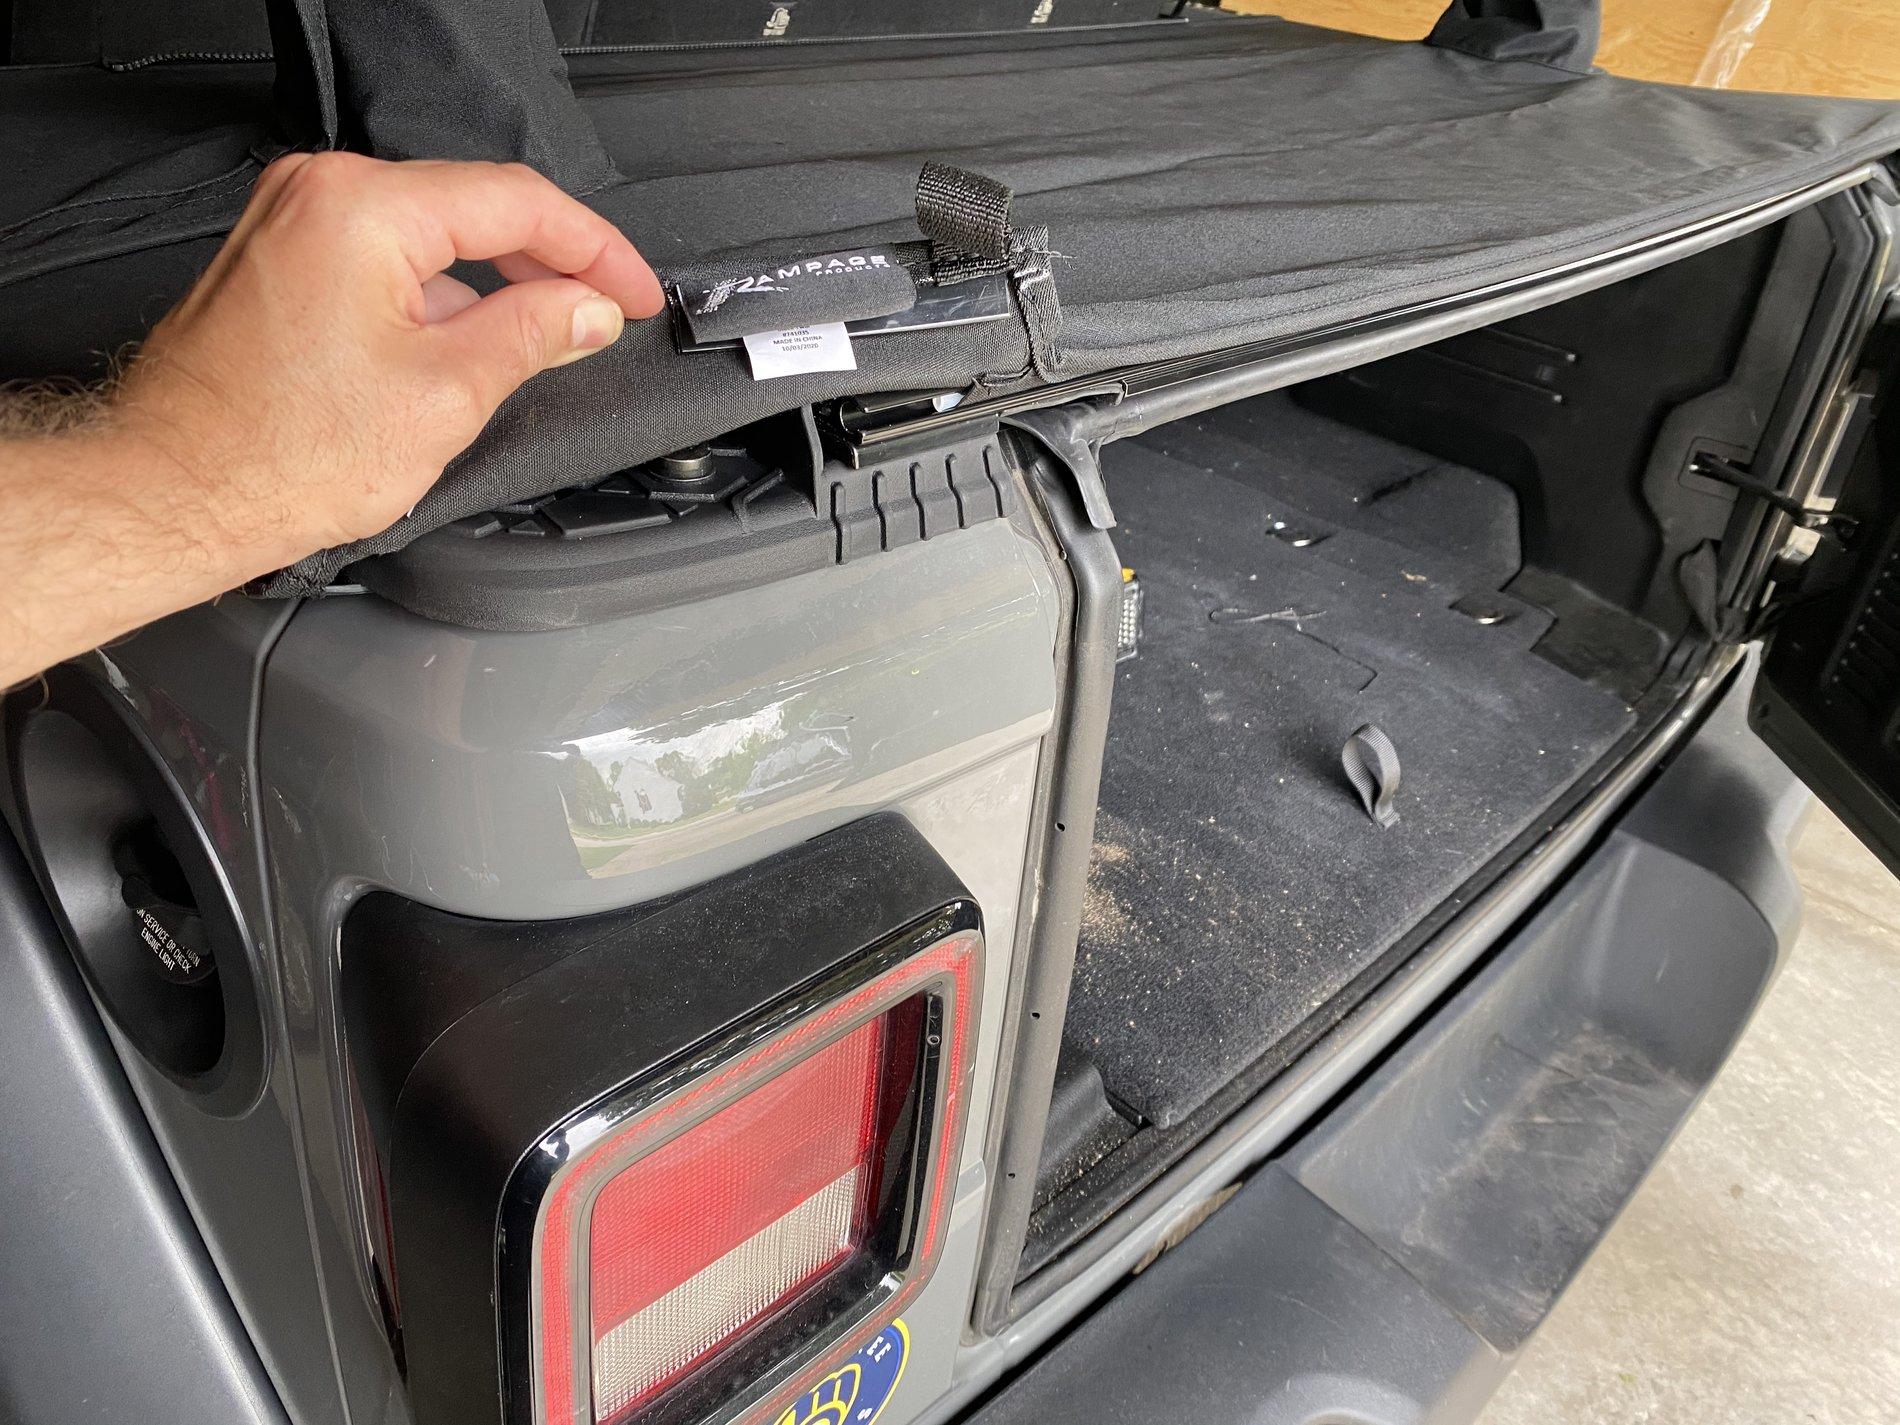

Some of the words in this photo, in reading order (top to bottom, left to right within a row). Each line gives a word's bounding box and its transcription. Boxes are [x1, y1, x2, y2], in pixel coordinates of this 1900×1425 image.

[815, 263, 891, 276] PRODUCTS
[140, 927, 162, 954] ENGINE
[158, 948, 176, 971] LIGHT
[143, 913, 170, 944] SERVICE
[165, 939, 177, 953] OR
[172, 948, 192, 974] CHECK
